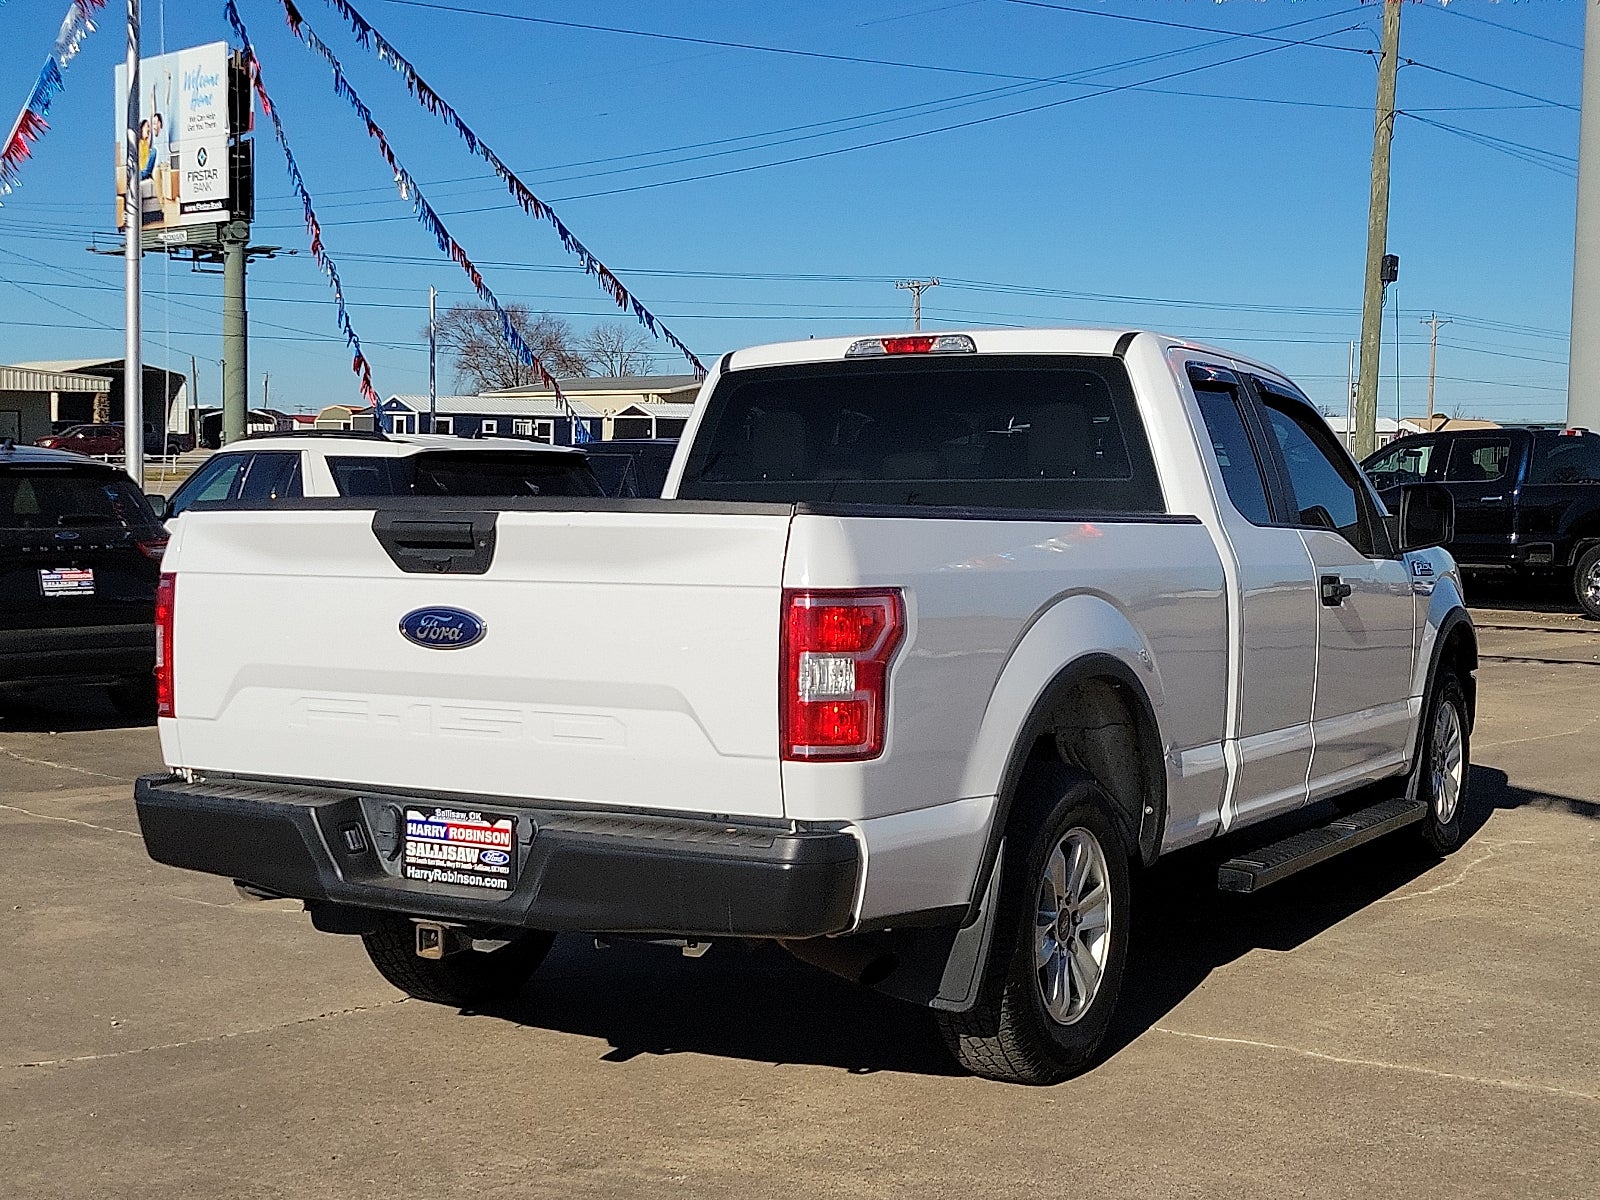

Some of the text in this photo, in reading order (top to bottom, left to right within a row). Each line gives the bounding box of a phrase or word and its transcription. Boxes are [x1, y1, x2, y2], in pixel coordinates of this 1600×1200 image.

[184, 64, 219, 91] Welcome
[189, 89, 213, 112] Home
[187, 169, 219, 182] FIRSTAR
[193, 182, 212, 193] BANK
[416, 614, 464, 641] Ford
[435, 808, 482, 821] Sallisaw, OK
[407, 822, 510, 846] HARRY ROBINSON
[405, 841, 480, 864] SALLISAW
[406, 865, 508, 889] HarryRobinson.com
